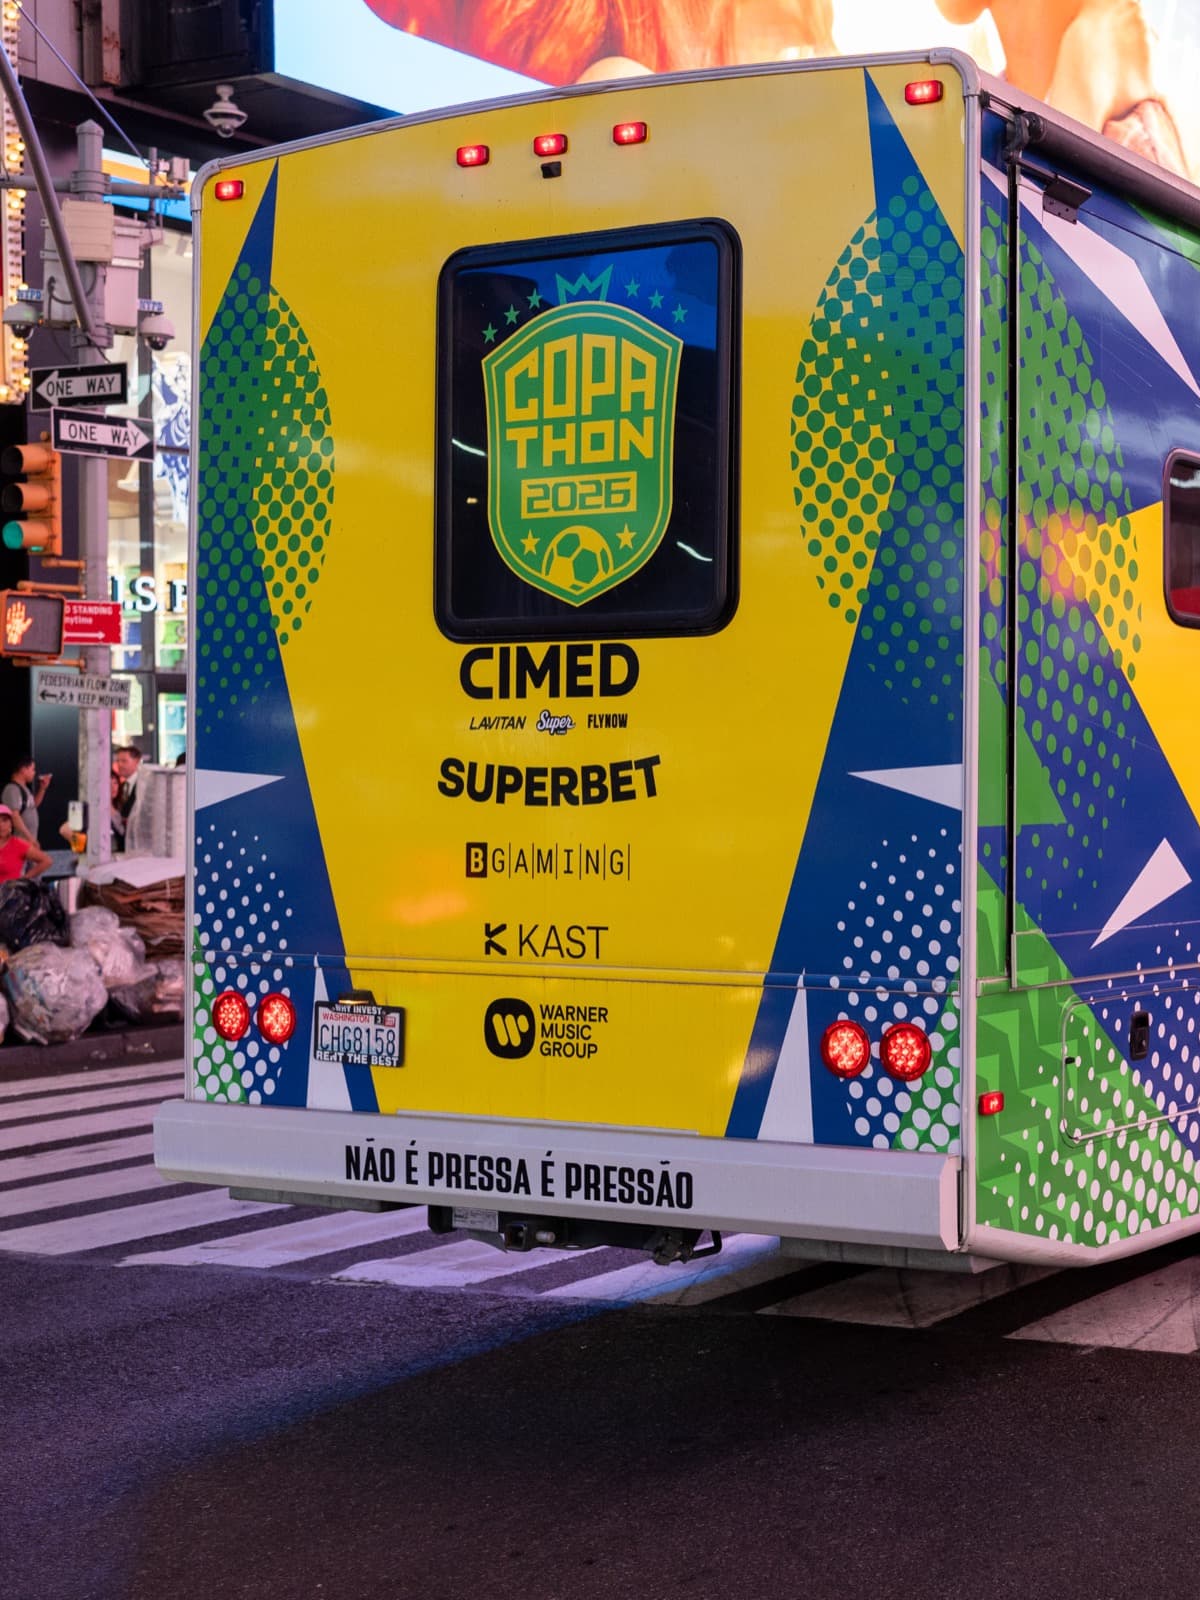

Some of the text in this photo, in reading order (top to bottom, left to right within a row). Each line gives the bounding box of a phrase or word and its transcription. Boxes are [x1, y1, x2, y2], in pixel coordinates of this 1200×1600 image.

[46, 376, 115, 397] ONE WAY
[504, 333, 657, 423] COPA
[68, 423, 140, 447] ONE WAY
[505, 416, 655, 470] THON
[526, 477, 631, 514] 2026
[65, 616, 93, 626] nytime
[73, 605, 113, 616] STANDING
[39, 671, 131, 693] PEDESTRIAN FLOW ZONE
[460, 643, 640, 699] CIMED
[78, 692, 129, 707] KEEP MOVING
[469, 710, 628, 734] LAVITAN Super FLYNOW
[437, 754, 662, 807] SUPERBET
[518, 923, 609, 960] KAST
[322, 1012, 370, 1024] WASHINGTON
[354, 1005, 383, 1015] INVEST
[539, 1004, 609, 1024] WARNER
[320, 1024, 396, 1057] CHG8158
[540, 1023, 592, 1041] MUSIC
[316, 1050, 399, 1067] RENT THE BEST
[539, 1040, 598, 1060] GROUP
[345, 1138, 694, 1210] NÃO É PRESSA É PRESSÃO
